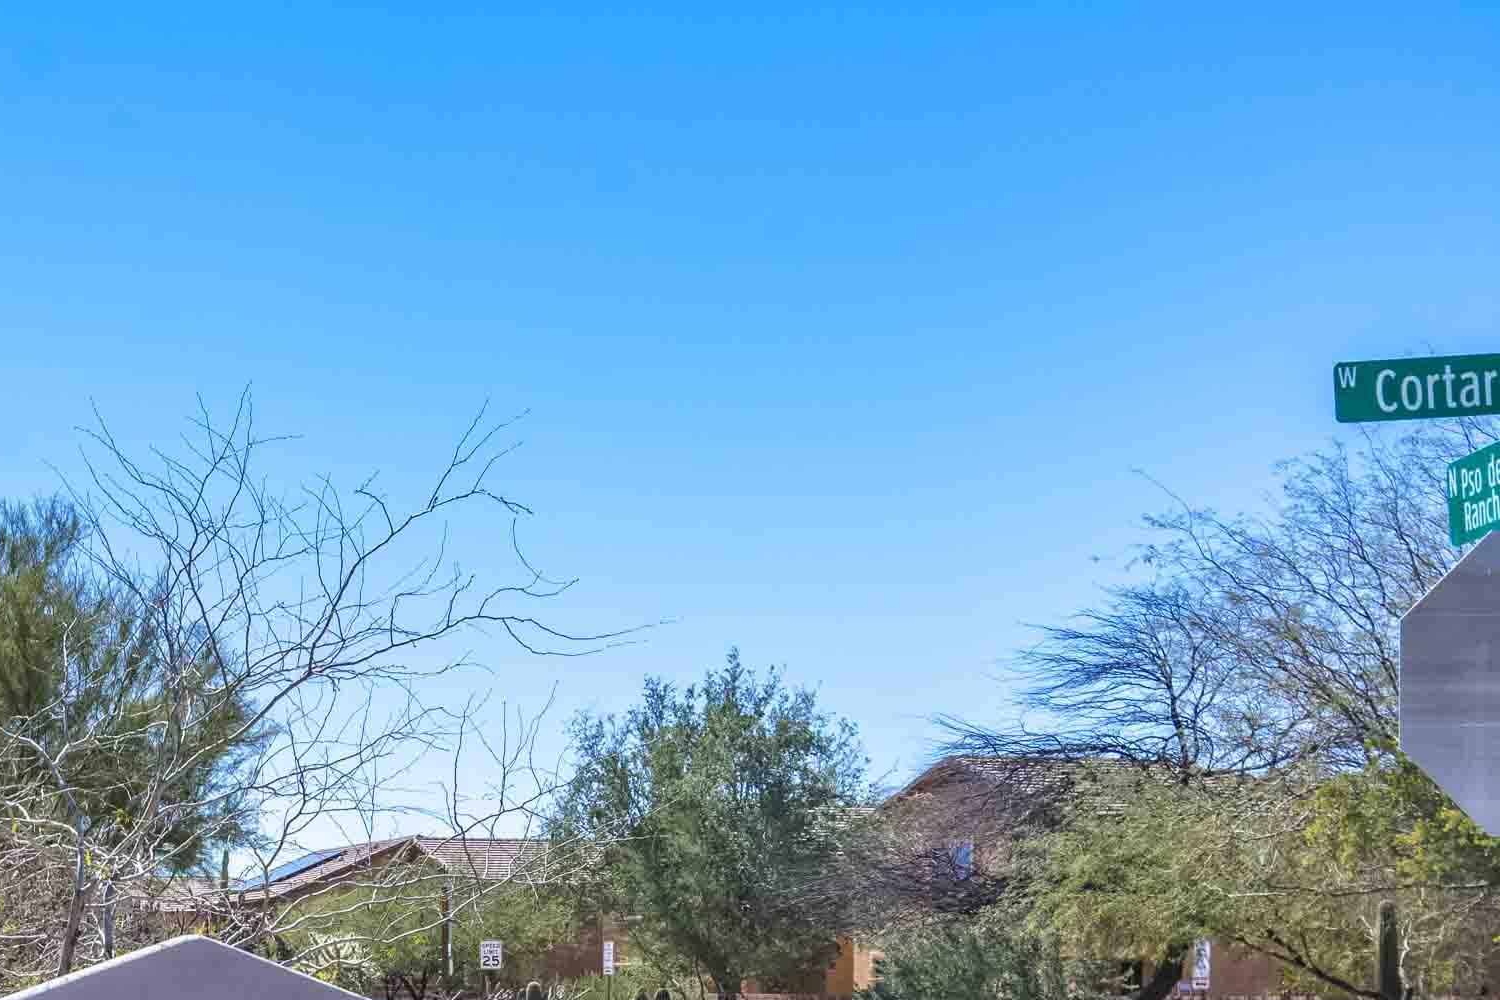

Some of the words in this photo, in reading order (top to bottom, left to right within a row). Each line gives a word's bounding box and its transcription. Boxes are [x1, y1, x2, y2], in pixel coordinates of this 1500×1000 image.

[1338, 366, 1357, 388] W
[1376, 365, 1498, 412] Cortar
[1449, 466, 1458, 498] N
[1461, 467, 1483, 499] Pso
[1464, 488, 1500, 532] Ranch
[483, 955, 500, 967] 25
